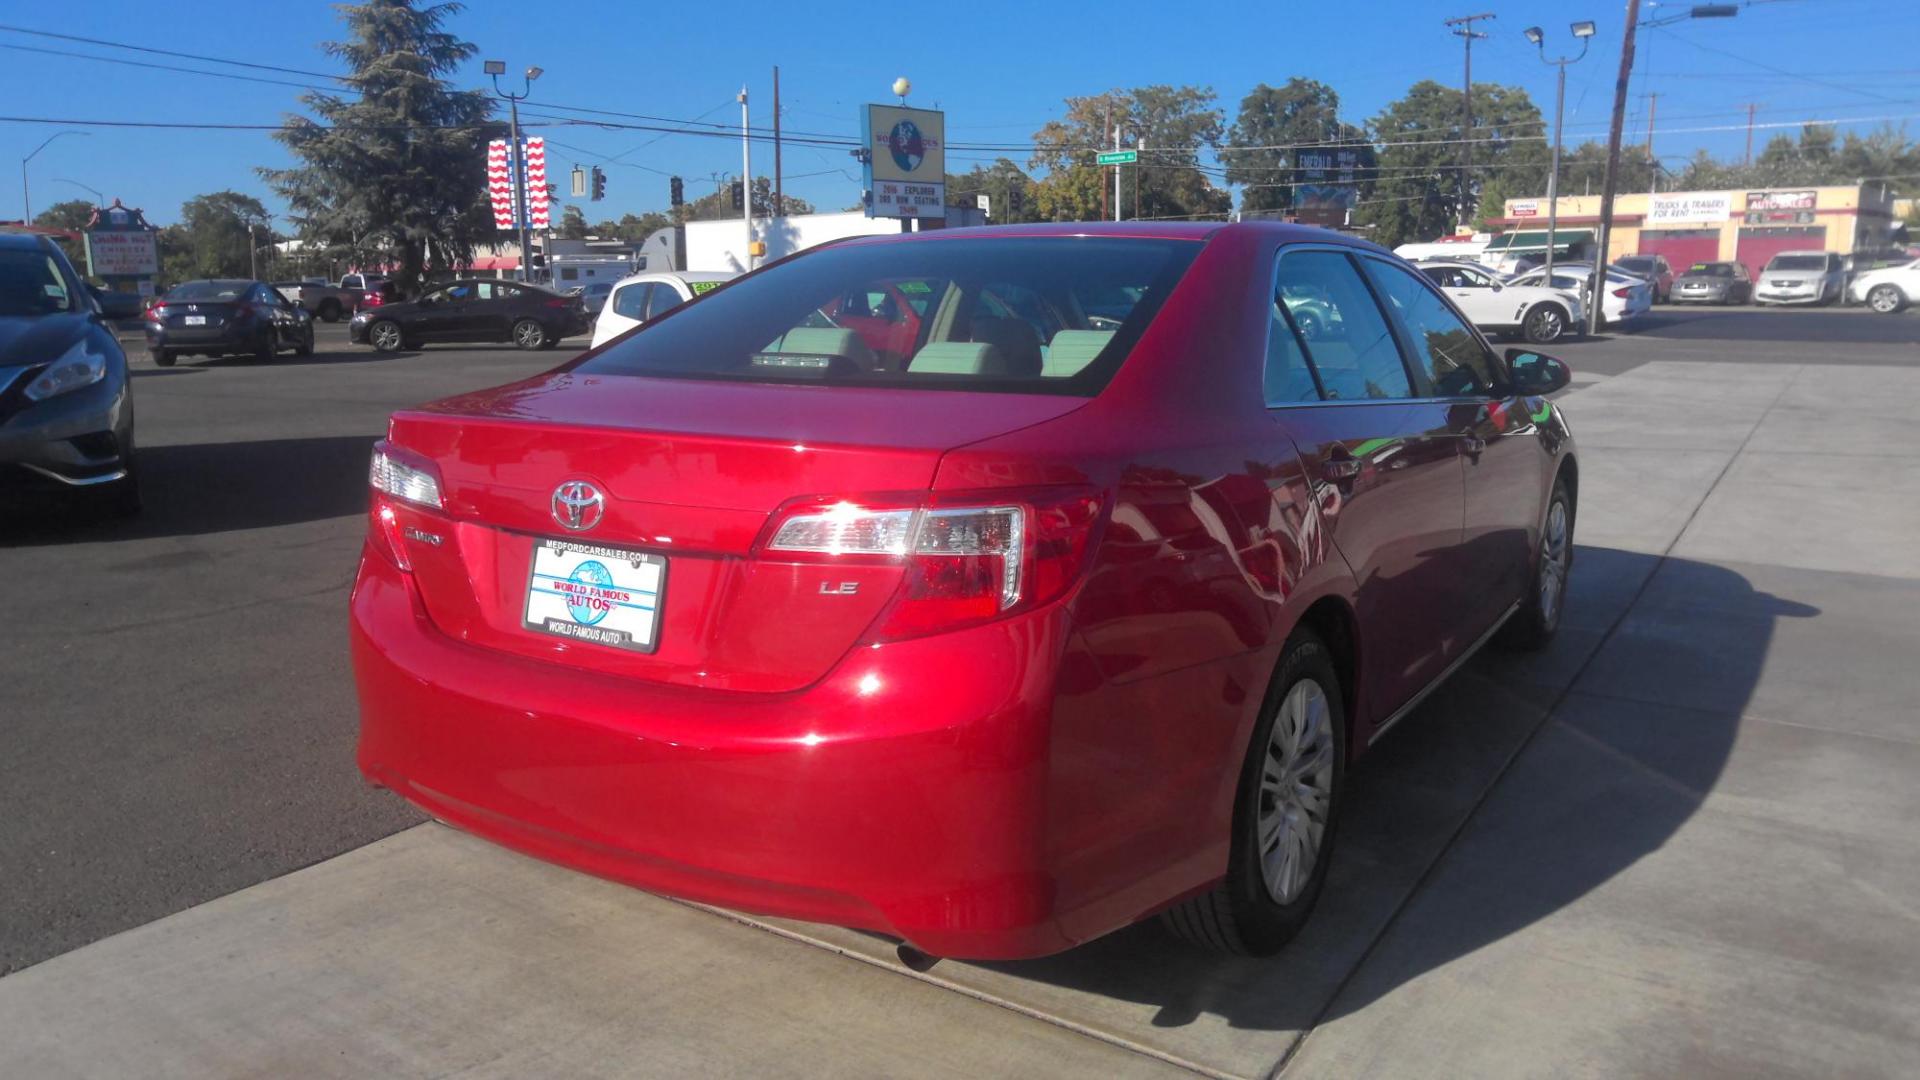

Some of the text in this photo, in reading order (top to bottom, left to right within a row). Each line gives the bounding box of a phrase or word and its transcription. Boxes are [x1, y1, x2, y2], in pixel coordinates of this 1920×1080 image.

[508, 166, 516, 223] FINANCE
[904, 186, 935, 195] EXPLORER
[914, 197, 940, 206] SEATING
[1653, 199, 1725, 209] TRUCKS & TRAILERS
[1653, 209, 1668, 218] FOR
[1670, 209, 1690, 217] RENT
[546, 540, 648, 562] MEDFORDCARSALES.COM
[553, 581, 630, 602] WORLD FAMOUS
[818, 581, 859, 595] LE
[568, 595, 611, 612] AUTOS
[549, 621, 620, 645] WORLD FAMOUS AUTO
